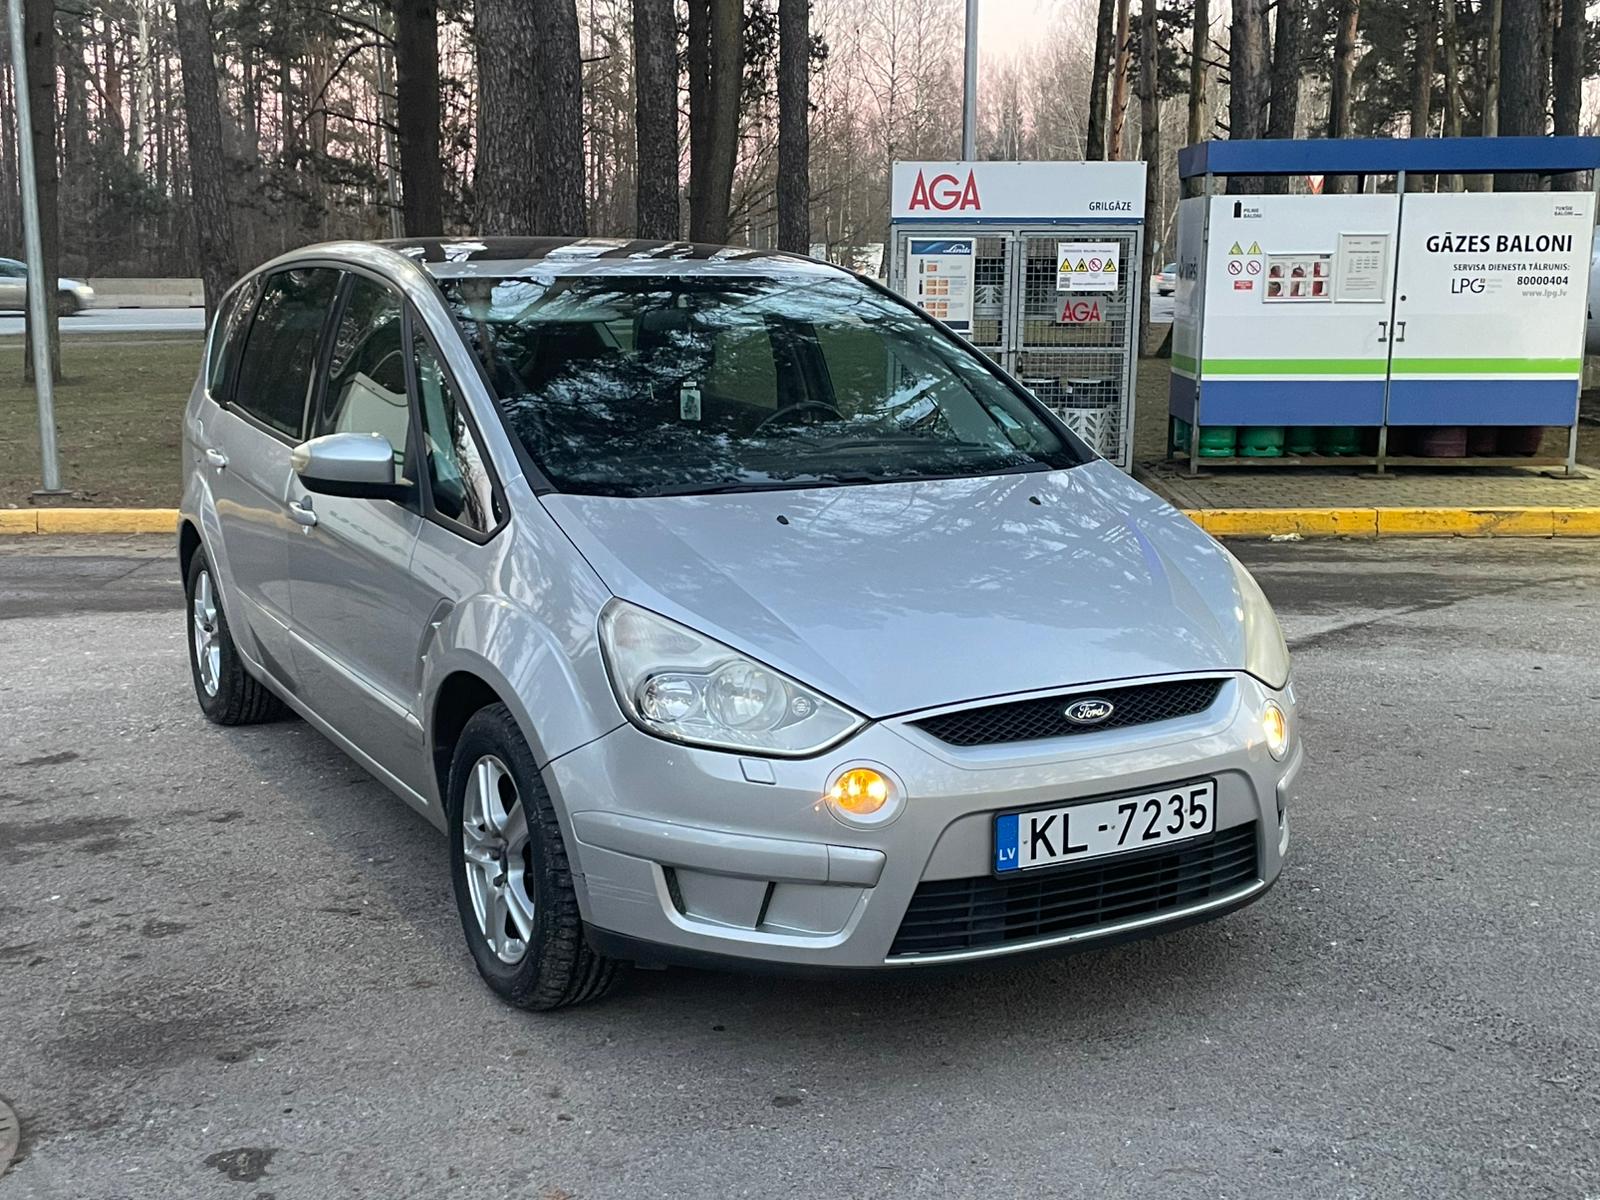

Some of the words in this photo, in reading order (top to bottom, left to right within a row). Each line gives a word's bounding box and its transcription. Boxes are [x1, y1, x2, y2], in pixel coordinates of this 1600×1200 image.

[908, 168, 982, 211] AGA
[1426, 231, 1490, 253] GĀZES
[1496, 234, 1573, 252] BALONI
[1453, 263, 1486, 272] SERVISA
[1488, 263, 1527, 271] DIENESTA
[1529, 261, 1571, 271] TĀLRUNIS:
[1517, 276, 1569, 285] 80000404
[1521, 289, 1568, 298] www.lpg.lv
[1061, 299, 1101, 322] AGA
[1077, 702, 1105, 719] Ford
[999, 847, 1016, 861] LV
